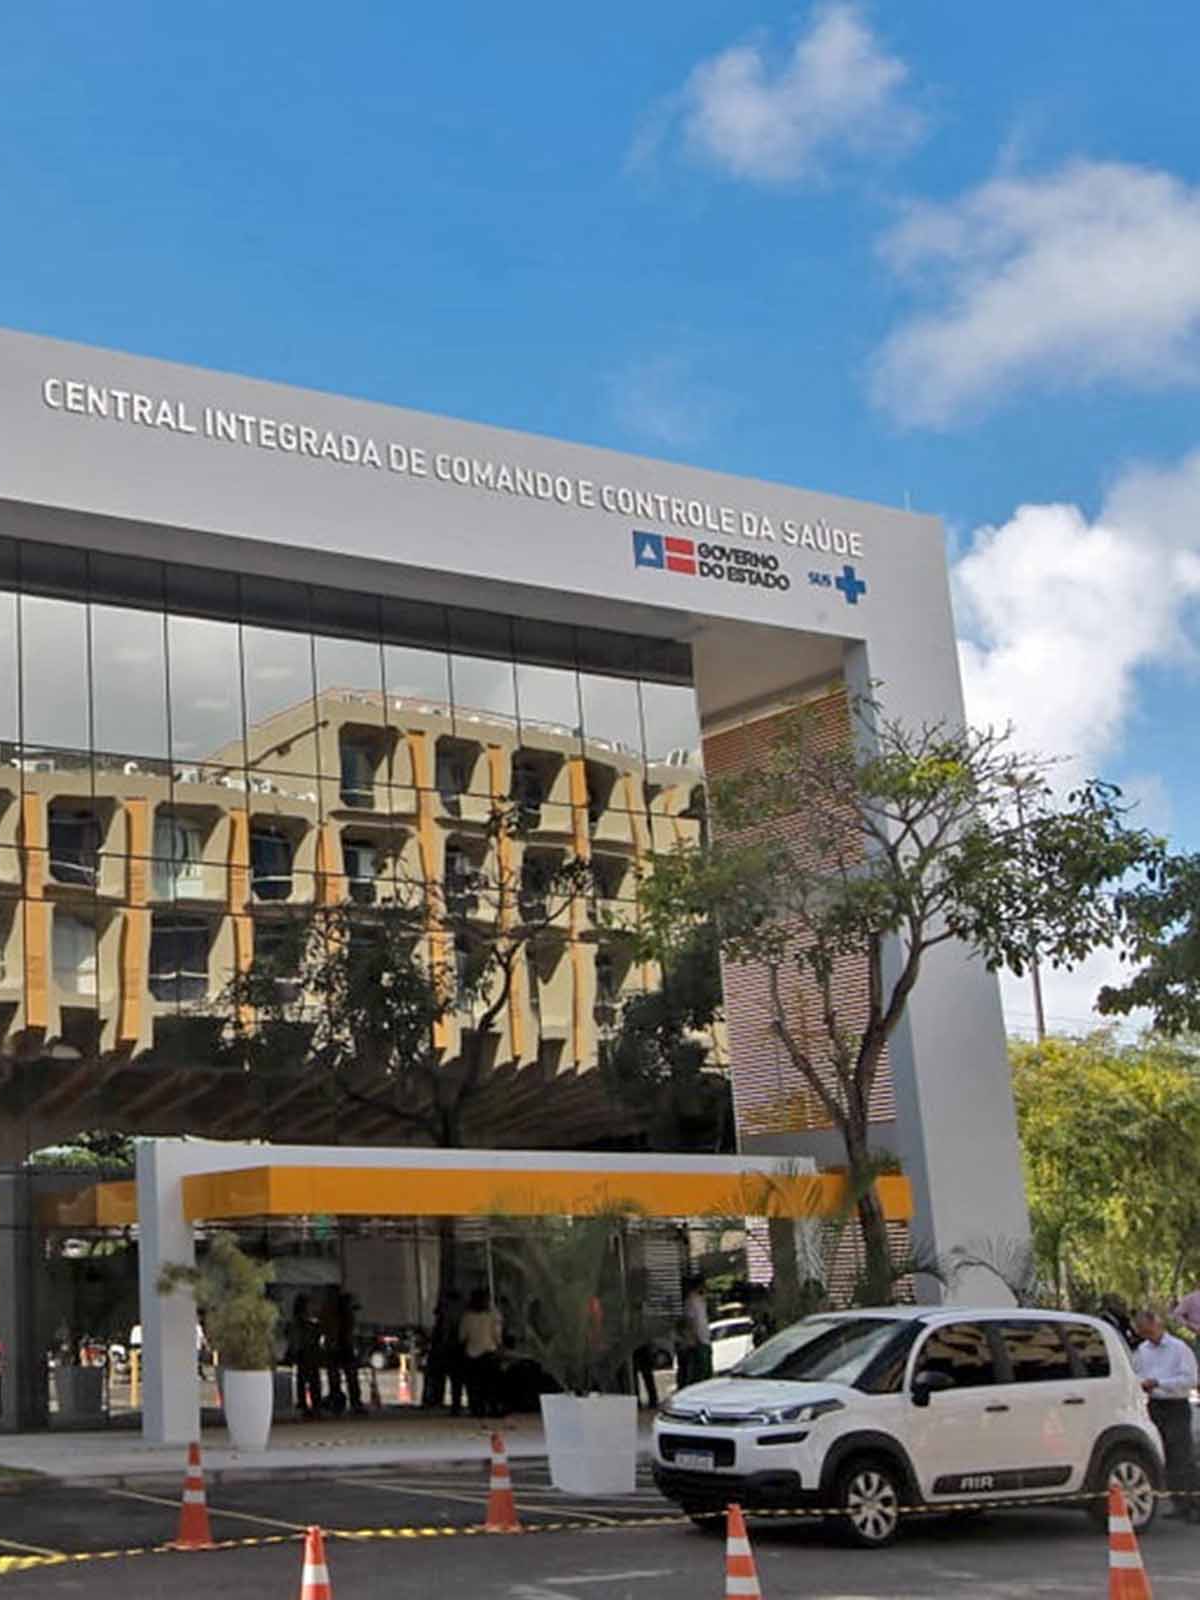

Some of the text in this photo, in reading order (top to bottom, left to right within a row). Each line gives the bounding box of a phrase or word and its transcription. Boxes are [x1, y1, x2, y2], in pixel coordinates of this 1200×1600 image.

[42, 378, 866, 558] CENTRAL INTEGRADA DE COMANDO E CONTROLE DA SAÚDE
[698, 543, 779, 571] GOVERNO
[699, 561, 790, 591] DO ESTADO
